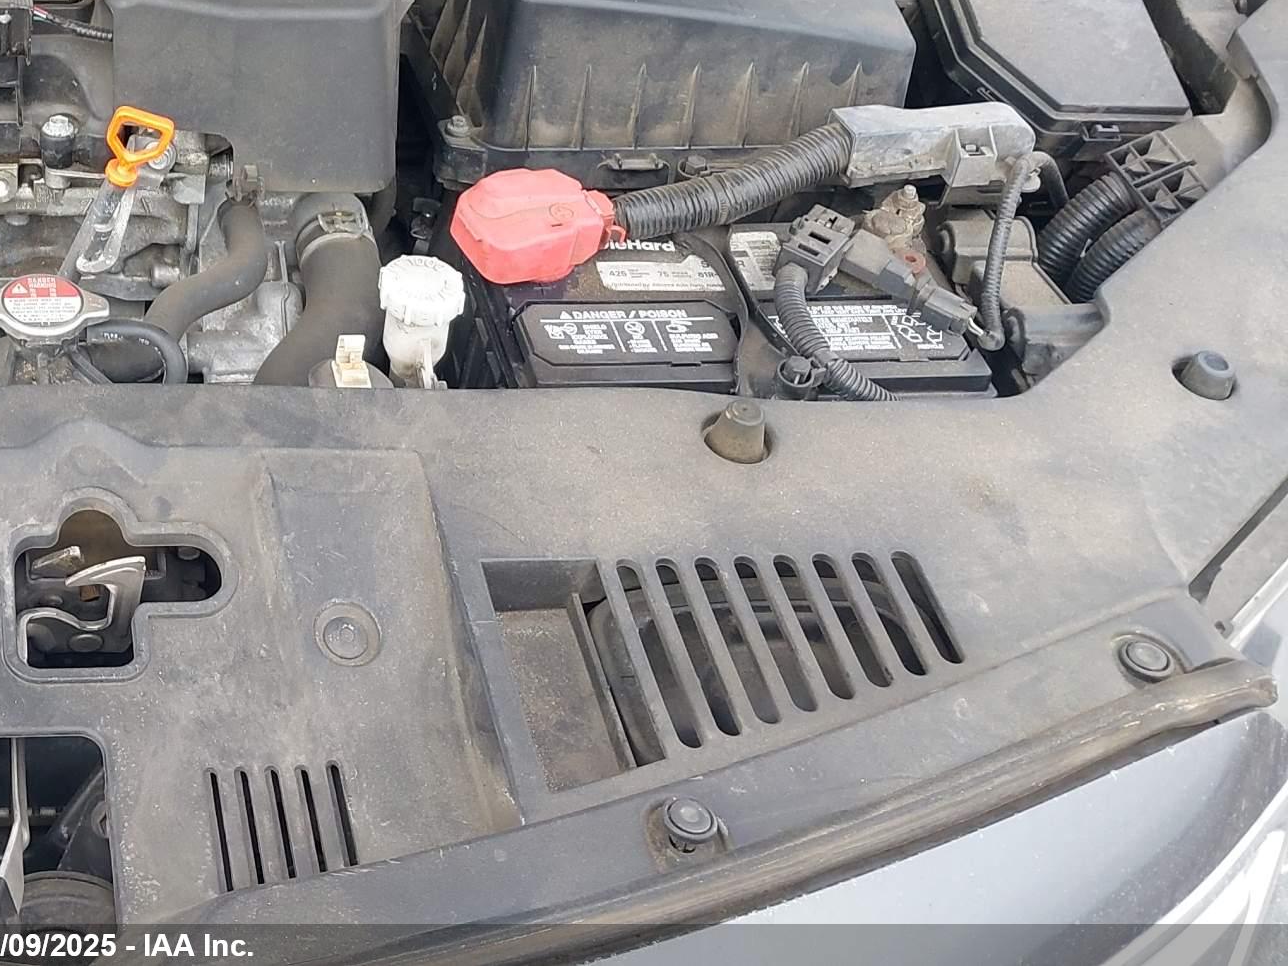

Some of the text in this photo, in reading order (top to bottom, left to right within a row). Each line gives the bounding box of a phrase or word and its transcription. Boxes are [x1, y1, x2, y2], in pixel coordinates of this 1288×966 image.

[605, 239, 676, 252] ieHard
[572, 310, 627, 319] DANGER
[638, 309, 688, 318] POISON
